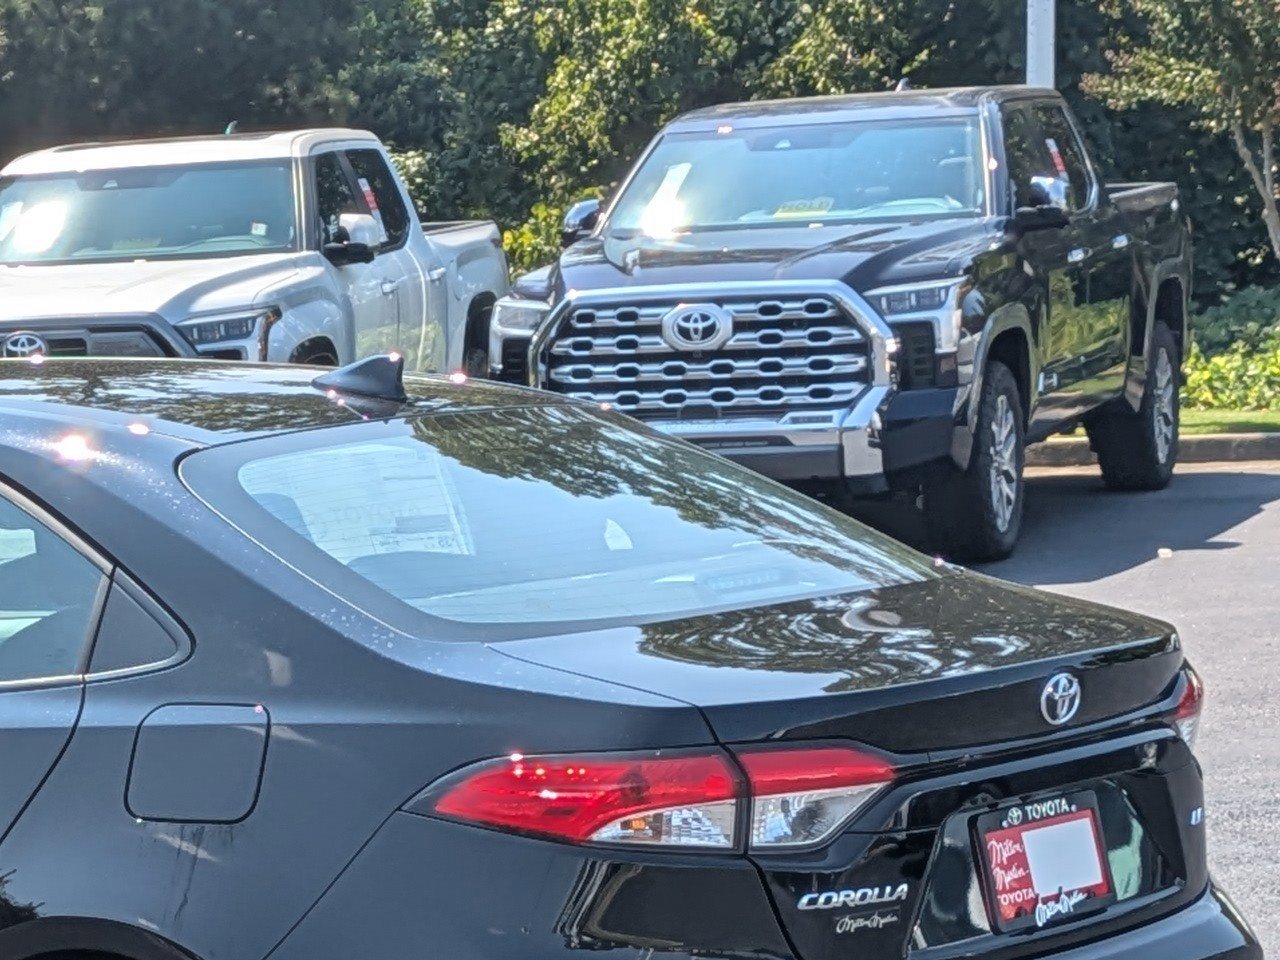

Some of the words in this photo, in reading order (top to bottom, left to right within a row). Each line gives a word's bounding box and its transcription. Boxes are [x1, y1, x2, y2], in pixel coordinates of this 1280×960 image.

[1024, 797, 1070, 821] TOYOTA
[796, 883, 909, 911] COROLLA
[996, 887, 1036, 906] TOYOTA
